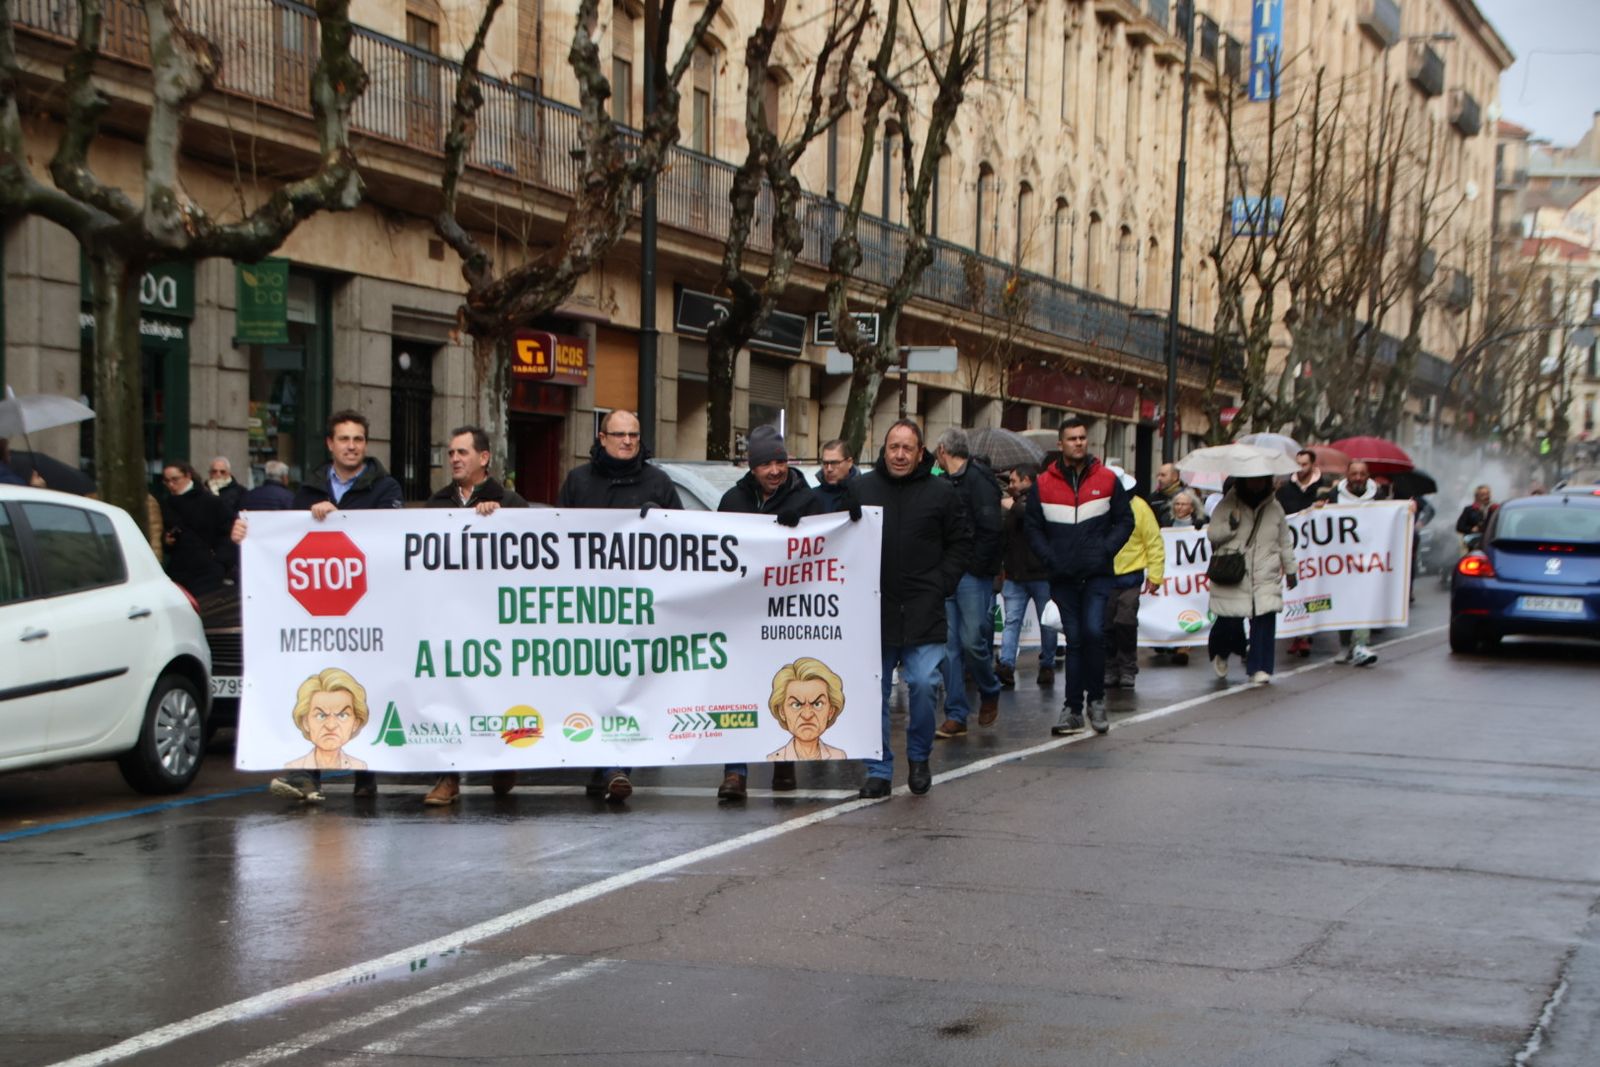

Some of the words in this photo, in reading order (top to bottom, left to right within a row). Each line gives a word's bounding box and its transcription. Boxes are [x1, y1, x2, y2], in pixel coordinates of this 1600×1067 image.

[512, 365, 549, 374] TABACOS
[404, 524, 561, 571] POLÍTICOS
[567, 532, 747, 577] TRAIDORES,
[787, 536, 826, 560] PAC
[289, 557, 364, 591] STOP
[763, 558, 846, 587] FUERTE;
[498, 586, 655, 625] DEFENDER
[767, 594, 840, 618] MENOS
[280, 627, 384, 653] MERCOSUR
[761, 624, 843, 641] BUROCRACIA
[414, 639, 436, 678] A
[444, 638, 502, 678] LOS
[512, 631, 728, 678] PRODUCTORES
[695, 705, 705, 713] DE
[708, 703, 759, 712] CAMPESINOS
[408, 721, 462, 736] ASAJA
[470, 716, 538, 732] COAG
[601, 715, 641, 732] UPA
[720, 712, 755, 728] UCCL
[668, 731, 696, 740] Castilla
